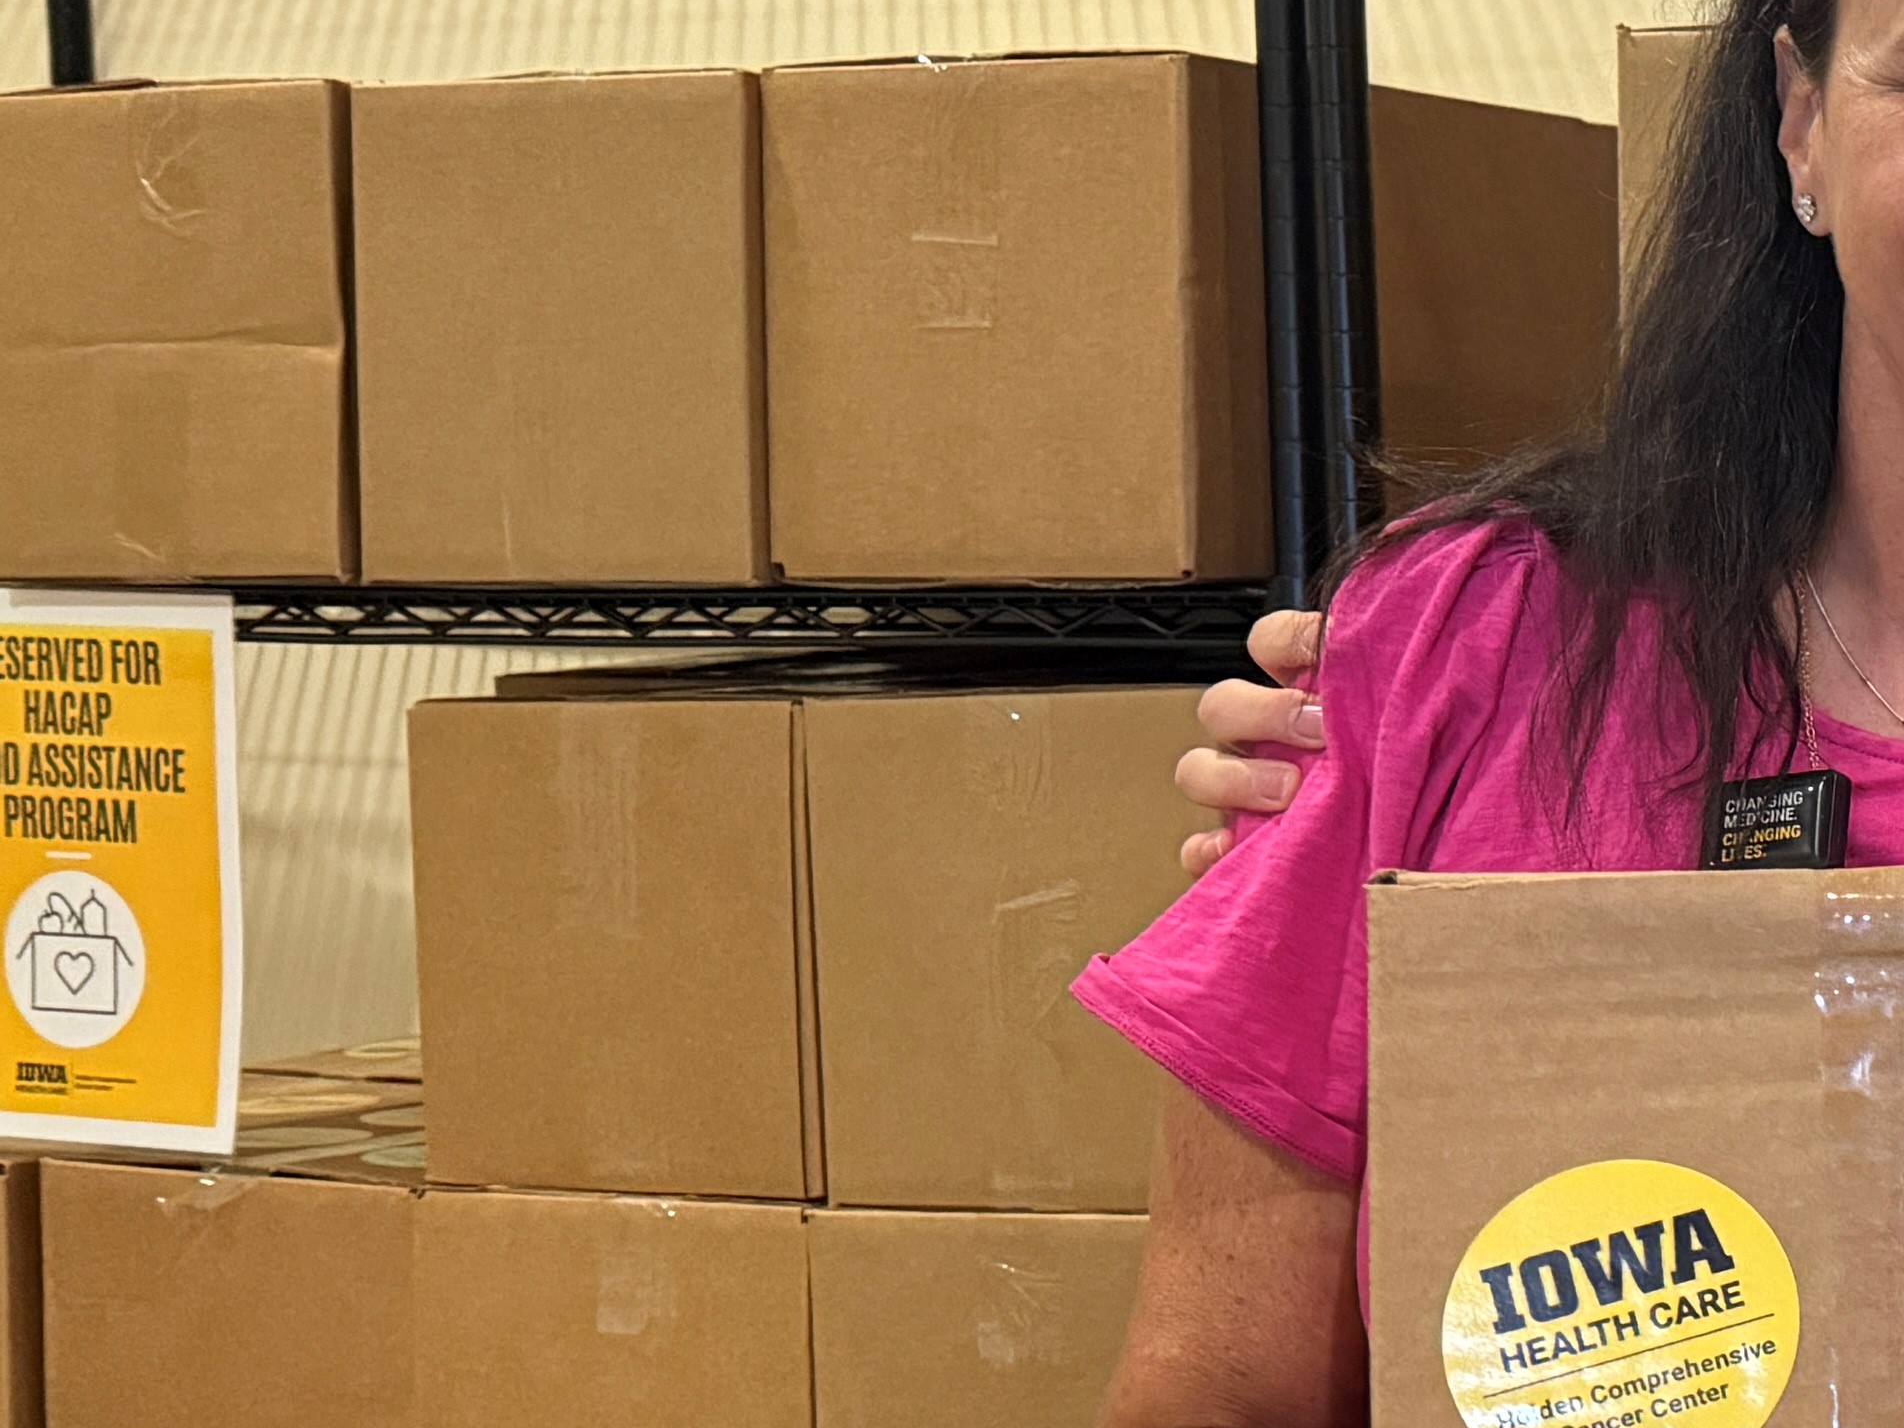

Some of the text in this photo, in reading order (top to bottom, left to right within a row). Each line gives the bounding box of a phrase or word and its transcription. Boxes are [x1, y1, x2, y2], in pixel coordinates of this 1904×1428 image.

[110, 639, 162, 686] FOR
[24, 689, 112, 737] HACAP
[27, 742, 186, 794] ASSISTANCE
[4, 794, 137, 844] PROGRAM
[1721, 844, 1767, 863] LIES.
[1479, 1208, 1735, 1335] IOWA
[1499, 1280, 1745, 1373] HEALTH CARE
[1589, 1339, 1777, 1405] Comprehensive
[1650, 1384, 1730, 1419] Center
